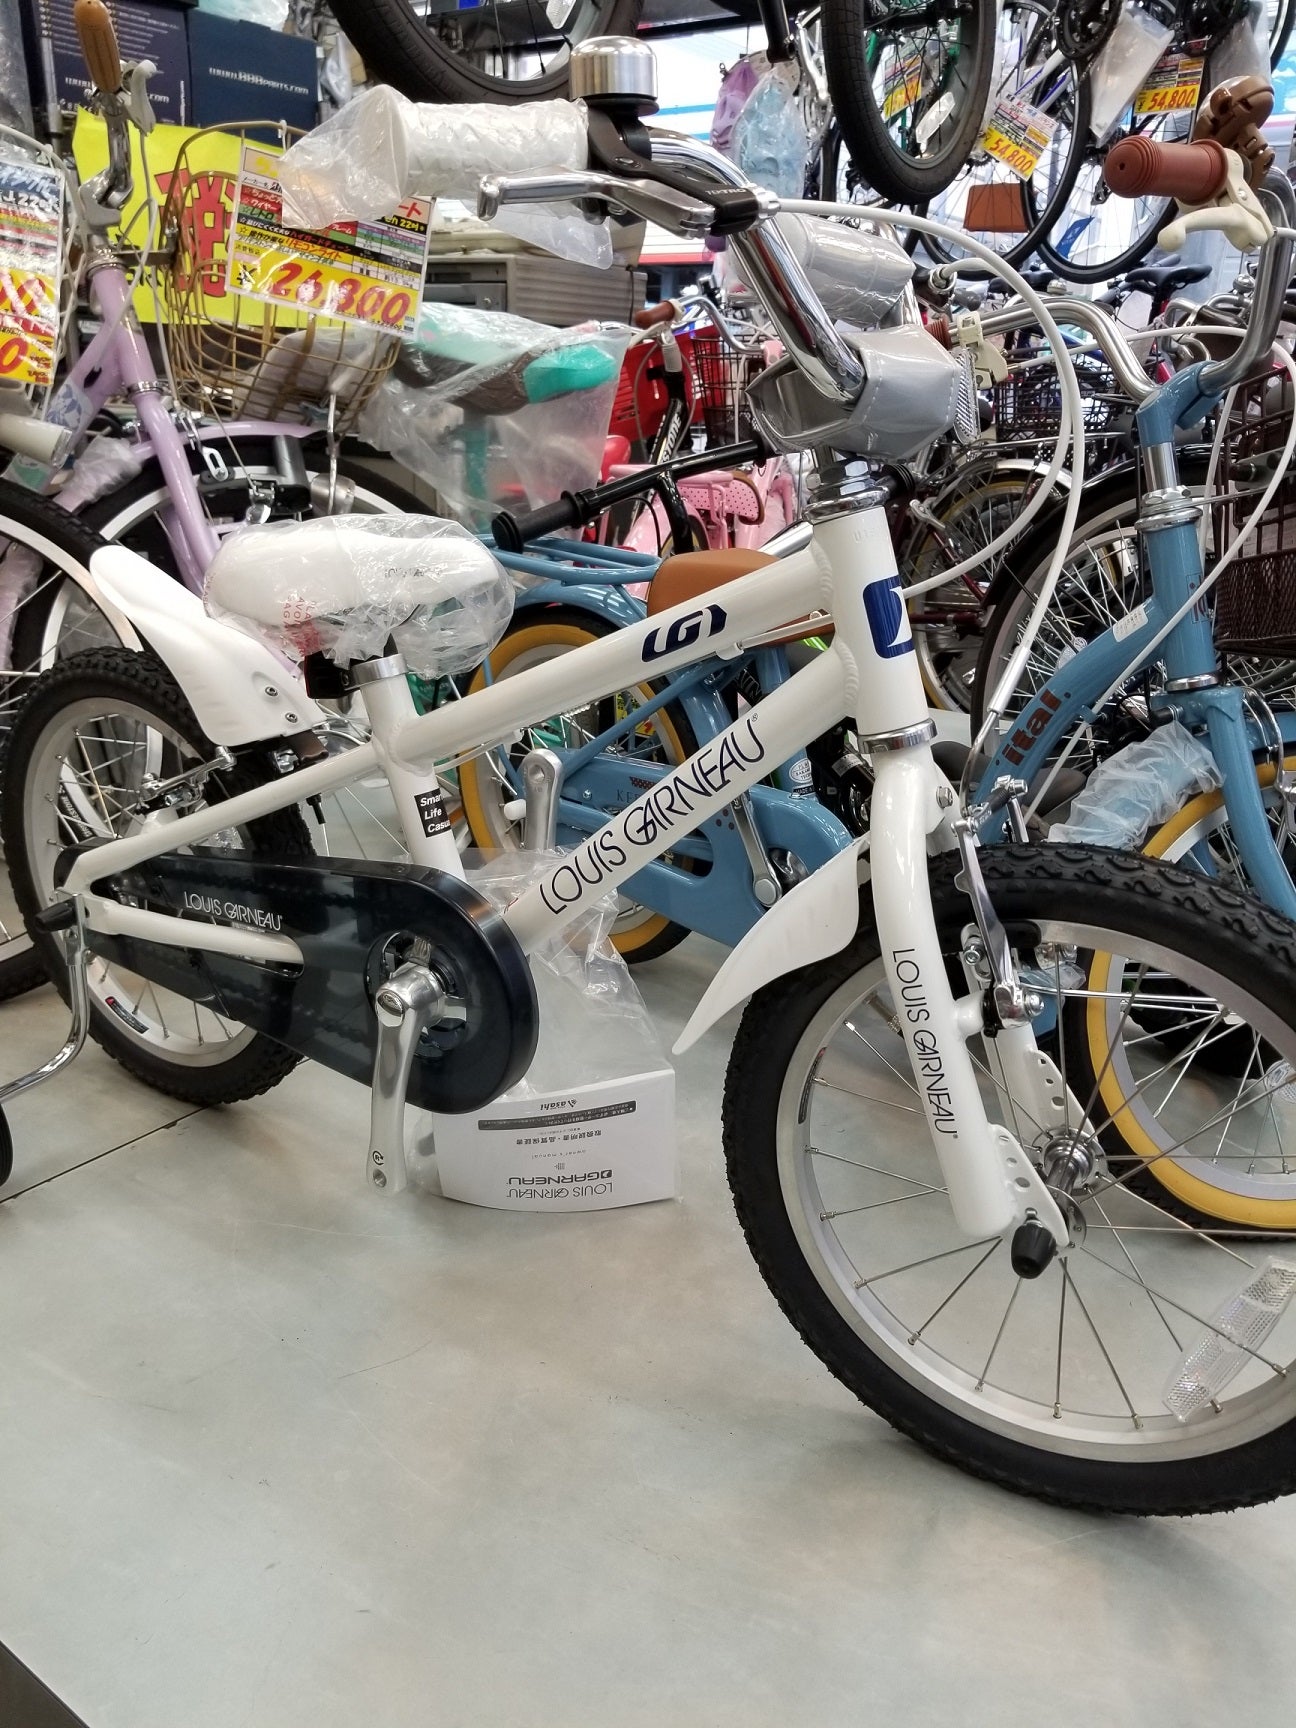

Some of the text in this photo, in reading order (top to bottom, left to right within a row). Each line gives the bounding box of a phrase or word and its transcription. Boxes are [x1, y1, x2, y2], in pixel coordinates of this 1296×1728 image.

[1147, 87, 1197, 111] 54,800
[989, 138, 1033, 172] 54,800
[420, 793, 443, 807] Smar
[424, 807, 442, 820] Life
[539, 830, 627, 915] LOUIS
[183, 891, 282, 931] LOUIS GARNEAU
[893, 948, 958, 1135] LOUIS GARNEAU
[540, 1100, 568, 1111] asahi
[508, 1170, 601, 1186] GARNEAU
[507, 1182, 613, 1199] LOUIS GARNEAU
